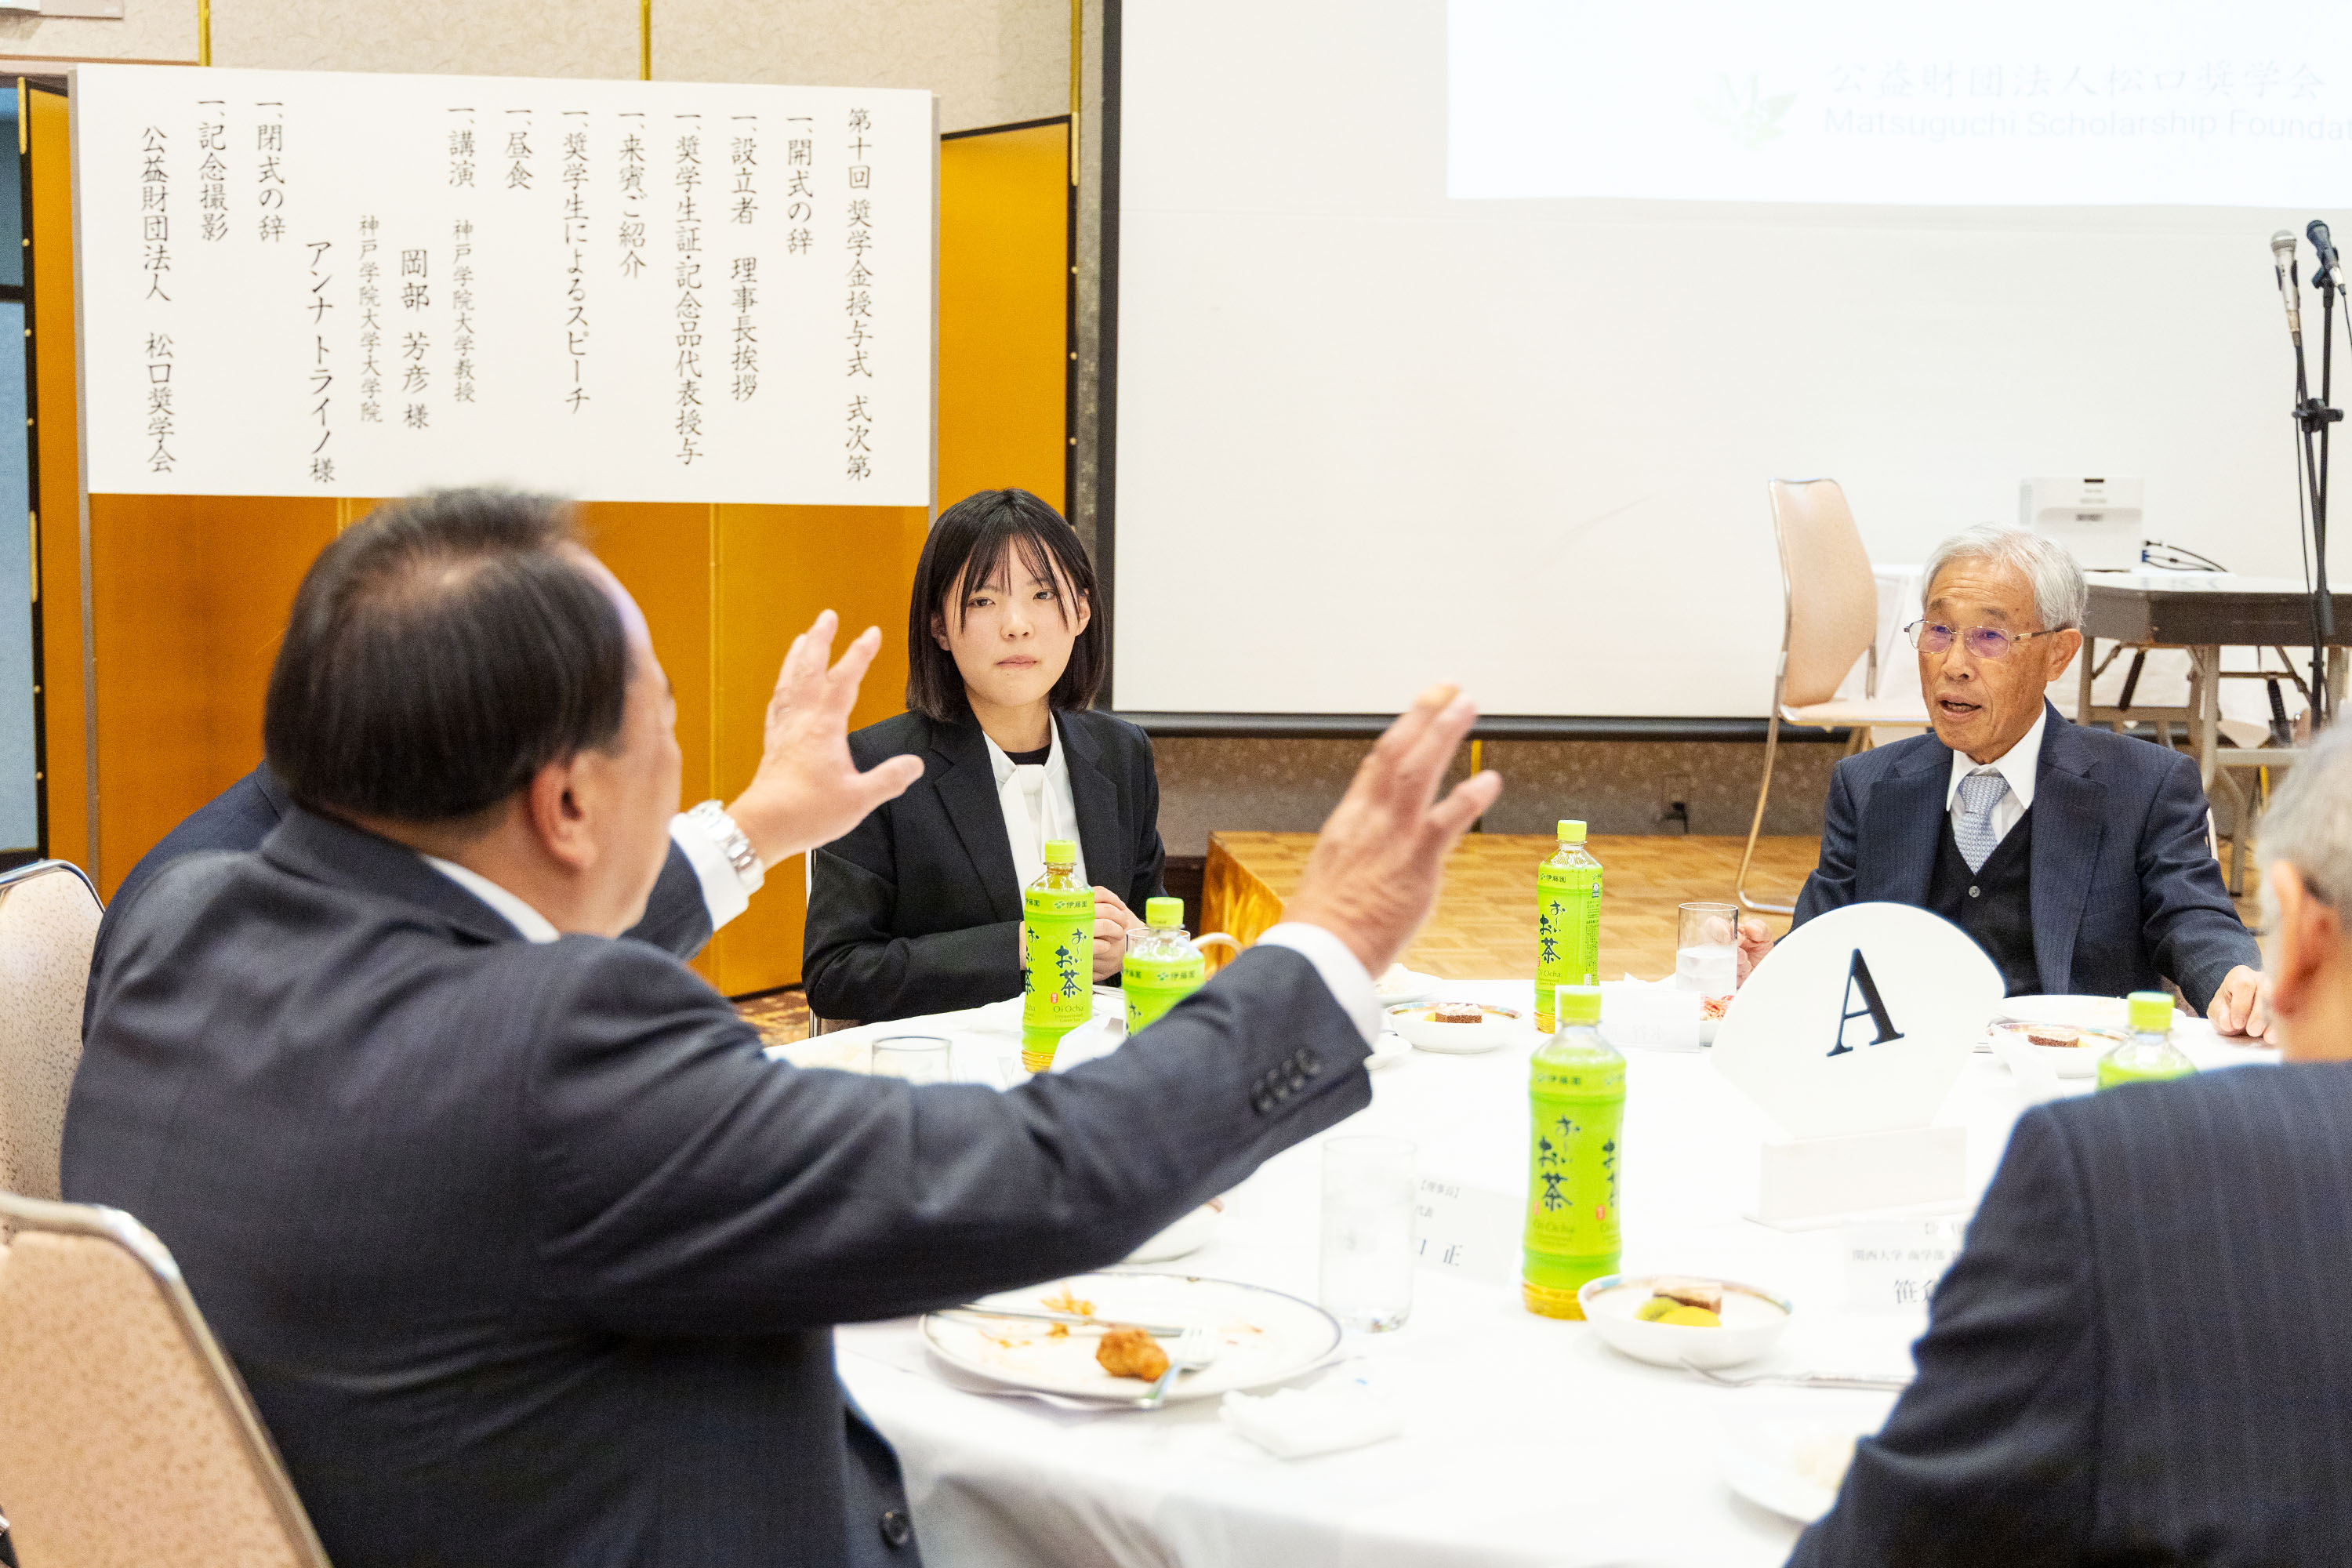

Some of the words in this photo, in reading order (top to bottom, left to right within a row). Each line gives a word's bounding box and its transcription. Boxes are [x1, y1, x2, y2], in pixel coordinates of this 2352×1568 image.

[198, 100, 229, 241] 一、記念撮影
[256, 102, 286, 242] 一、閉式の辞
[448, 107, 476, 188] 一、講演
[505, 109, 534, 191] 一、昼食
[731, 115, 759, 225] 一、設立者
[848, 108, 872, 190] 第十回
[1824, 107, 2016, 144] Matsuguchi
[2027, 108, 2217, 141] Scholarship
[140, 126, 172, 302] 公益財団法人
[618, 112, 648, 278] 一、来賓ご紹介
[786, 117, 814, 255] 一、開式の辞
[401, 249, 430, 312] 岡部
[453, 219, 475, 403] 神戸学院大学教授
[561, 111, 590, 413] 一、奨学生によるスピーチ
[845, 198, 873, 378] 奨学金授与式
[359, 215, 383, 423] 神戸学院大学大学院
[401, 331, 430, 394] 芳彦
[731, 256, 759, 401] 理事長挨拶
[145, 332, 176, 474] 松口奨学会
[403, 403, 430, 430] 様
[845, 394, 873, 481] 式次第
[1054, 945, 1083, 999] お茶
[1539, 913, 1562, 964] お茶
[1826, 948, 1905, 1058] A
